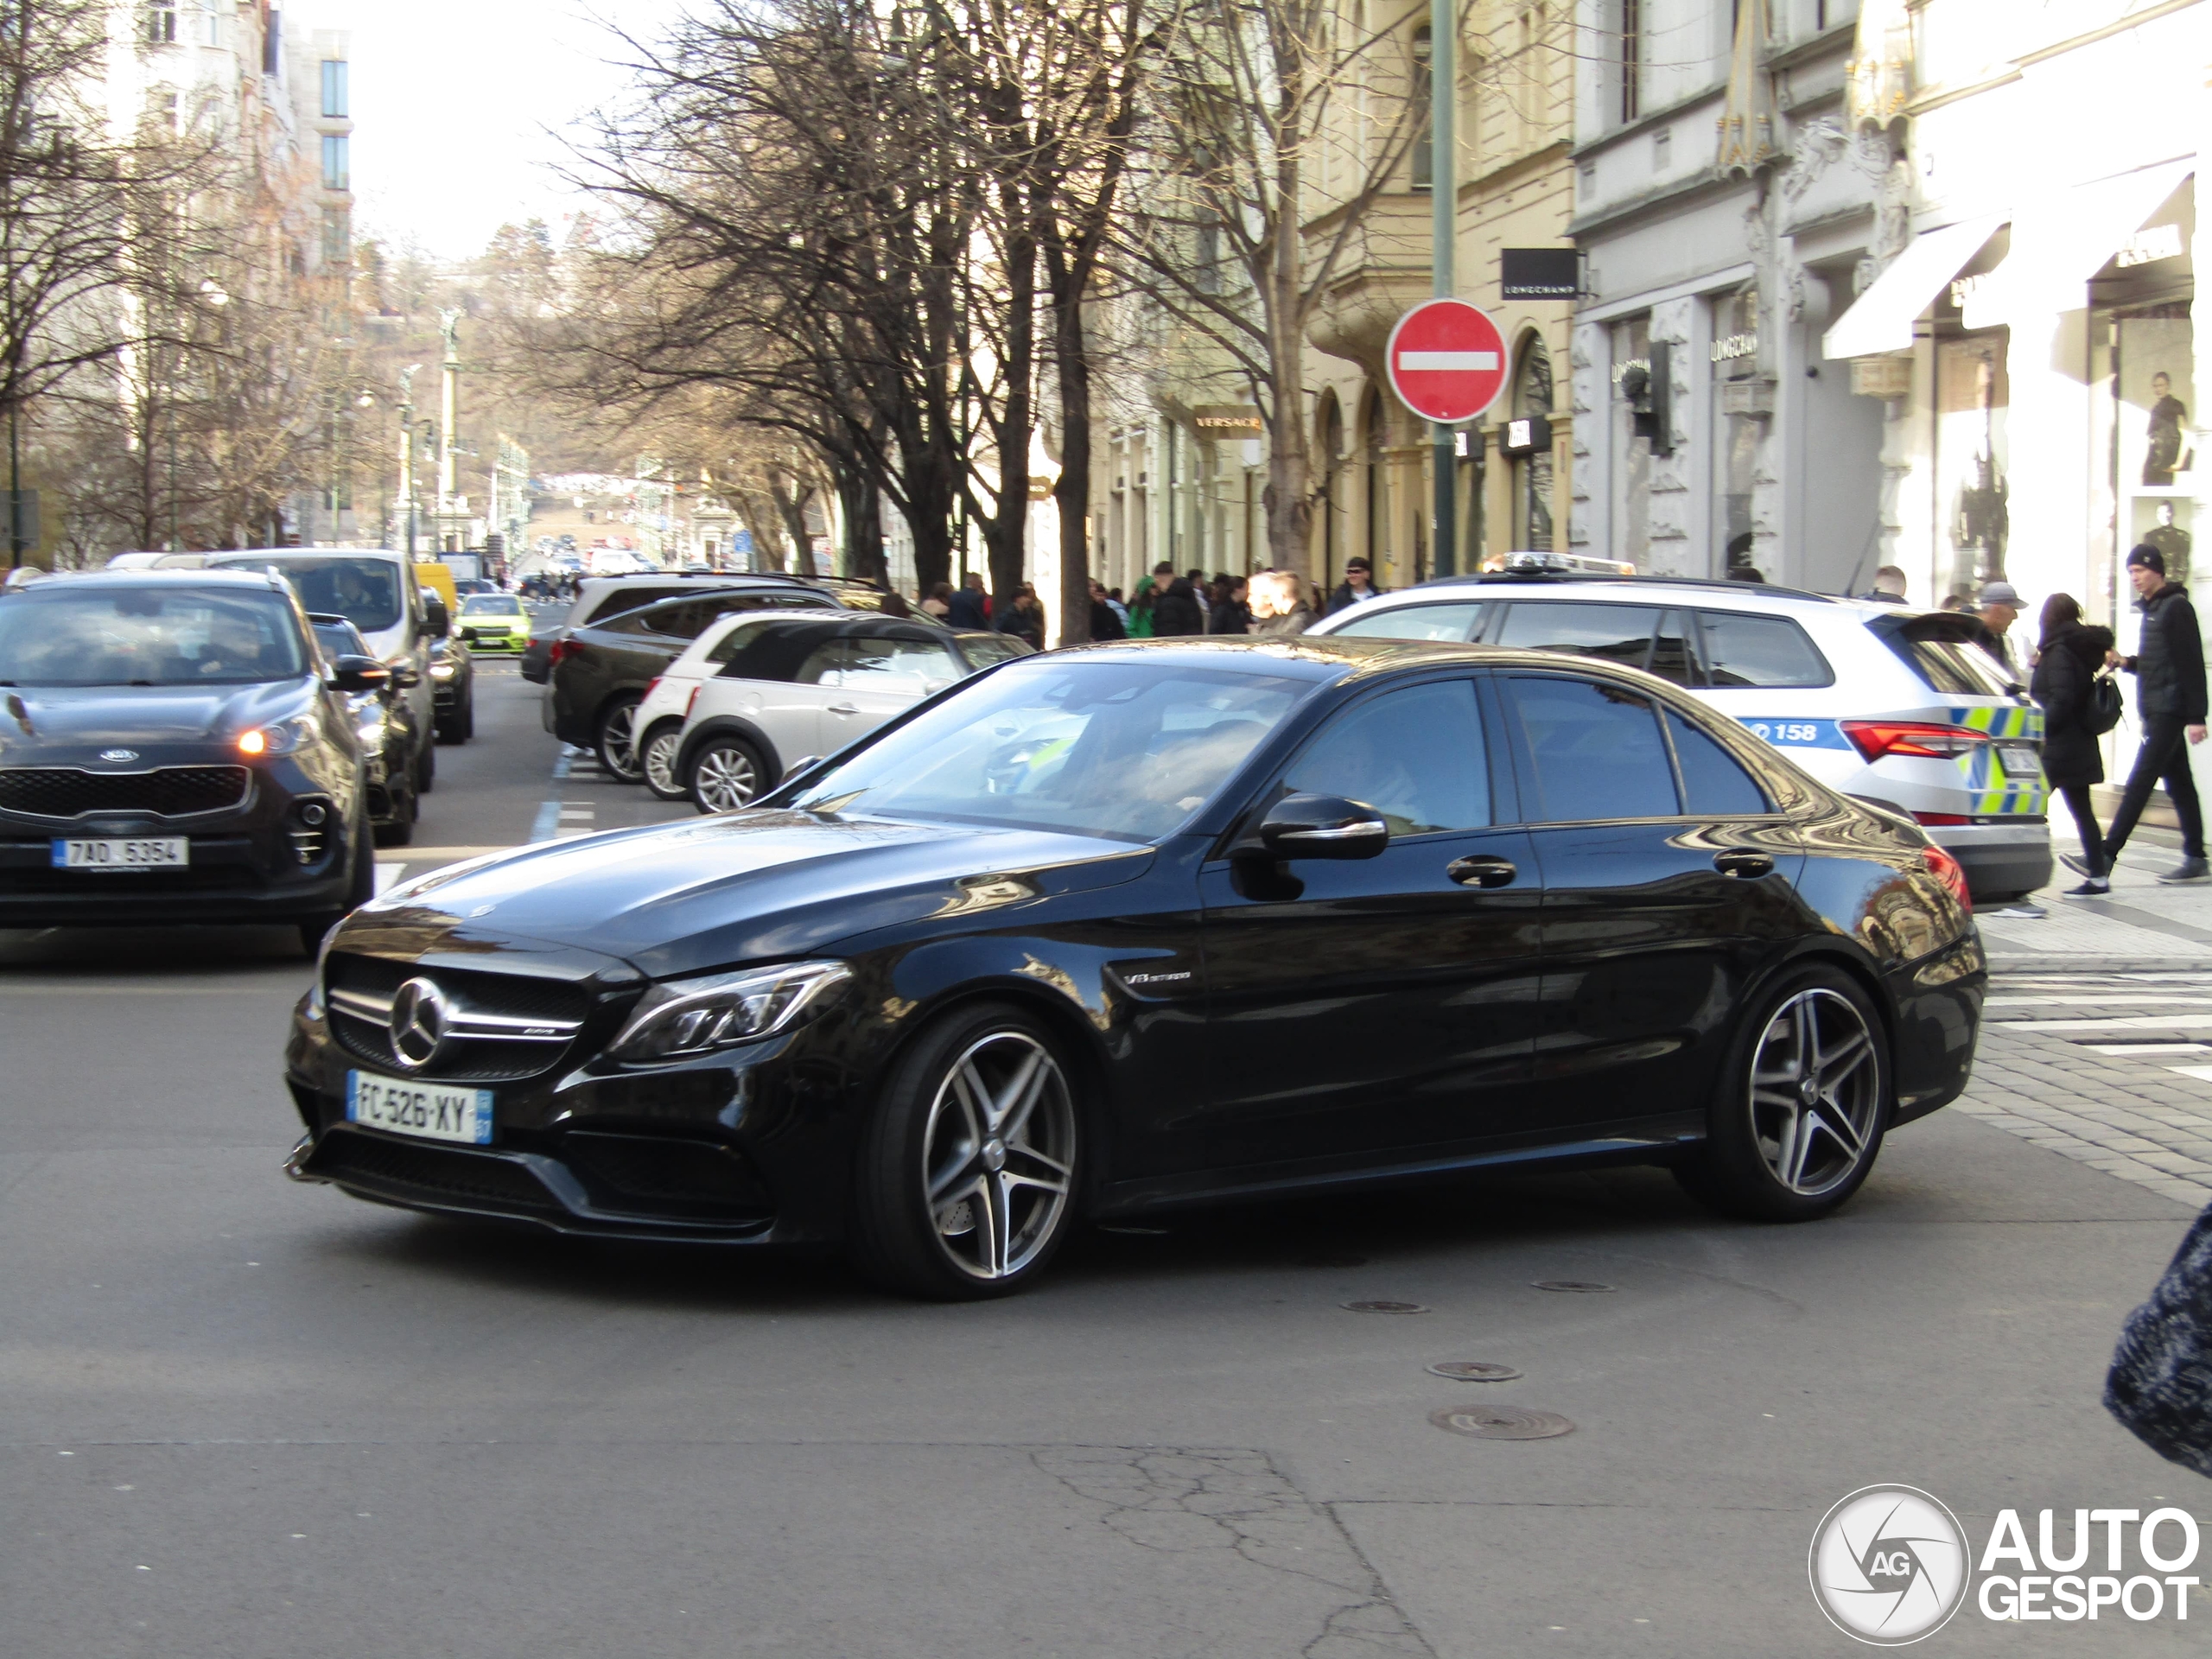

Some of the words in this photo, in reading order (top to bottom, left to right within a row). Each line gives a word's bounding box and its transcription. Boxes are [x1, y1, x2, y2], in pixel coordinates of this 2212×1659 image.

[1196, 417, 1261, 429] VERSACE
[1775, 724, 1817, 741] 158
[125, 842, 177, 862] 5354
